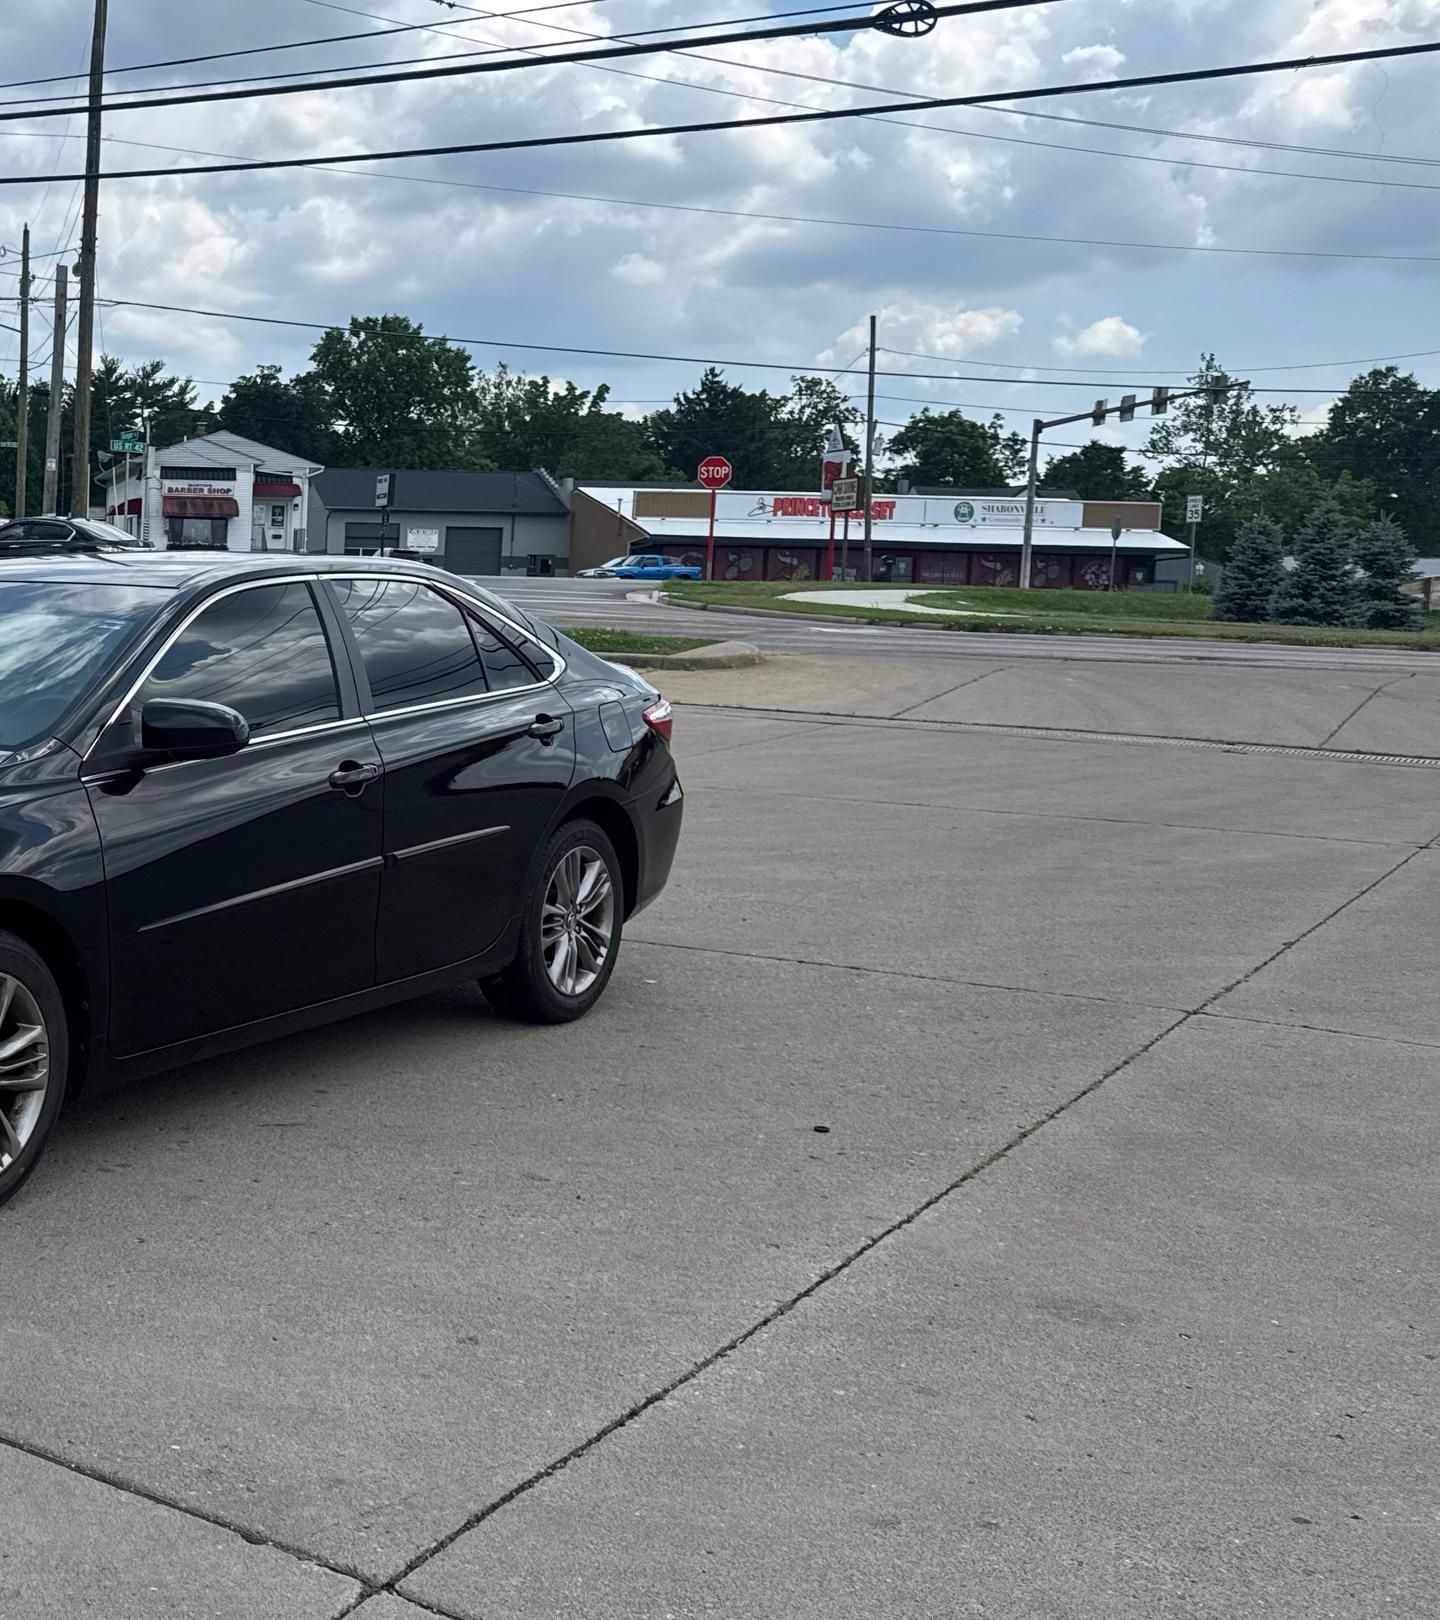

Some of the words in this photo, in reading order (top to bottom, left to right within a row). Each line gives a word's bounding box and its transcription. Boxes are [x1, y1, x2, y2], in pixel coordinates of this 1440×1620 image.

[113, 441, 123, 450] US
[134, 444, 144, 452] 42
[700, 466, 729, 479] STOP
[167, 486, 205, 494] BARBER
[207, 487, 233, 495] SHOP
[1188, 509, 1200, 519] 35
